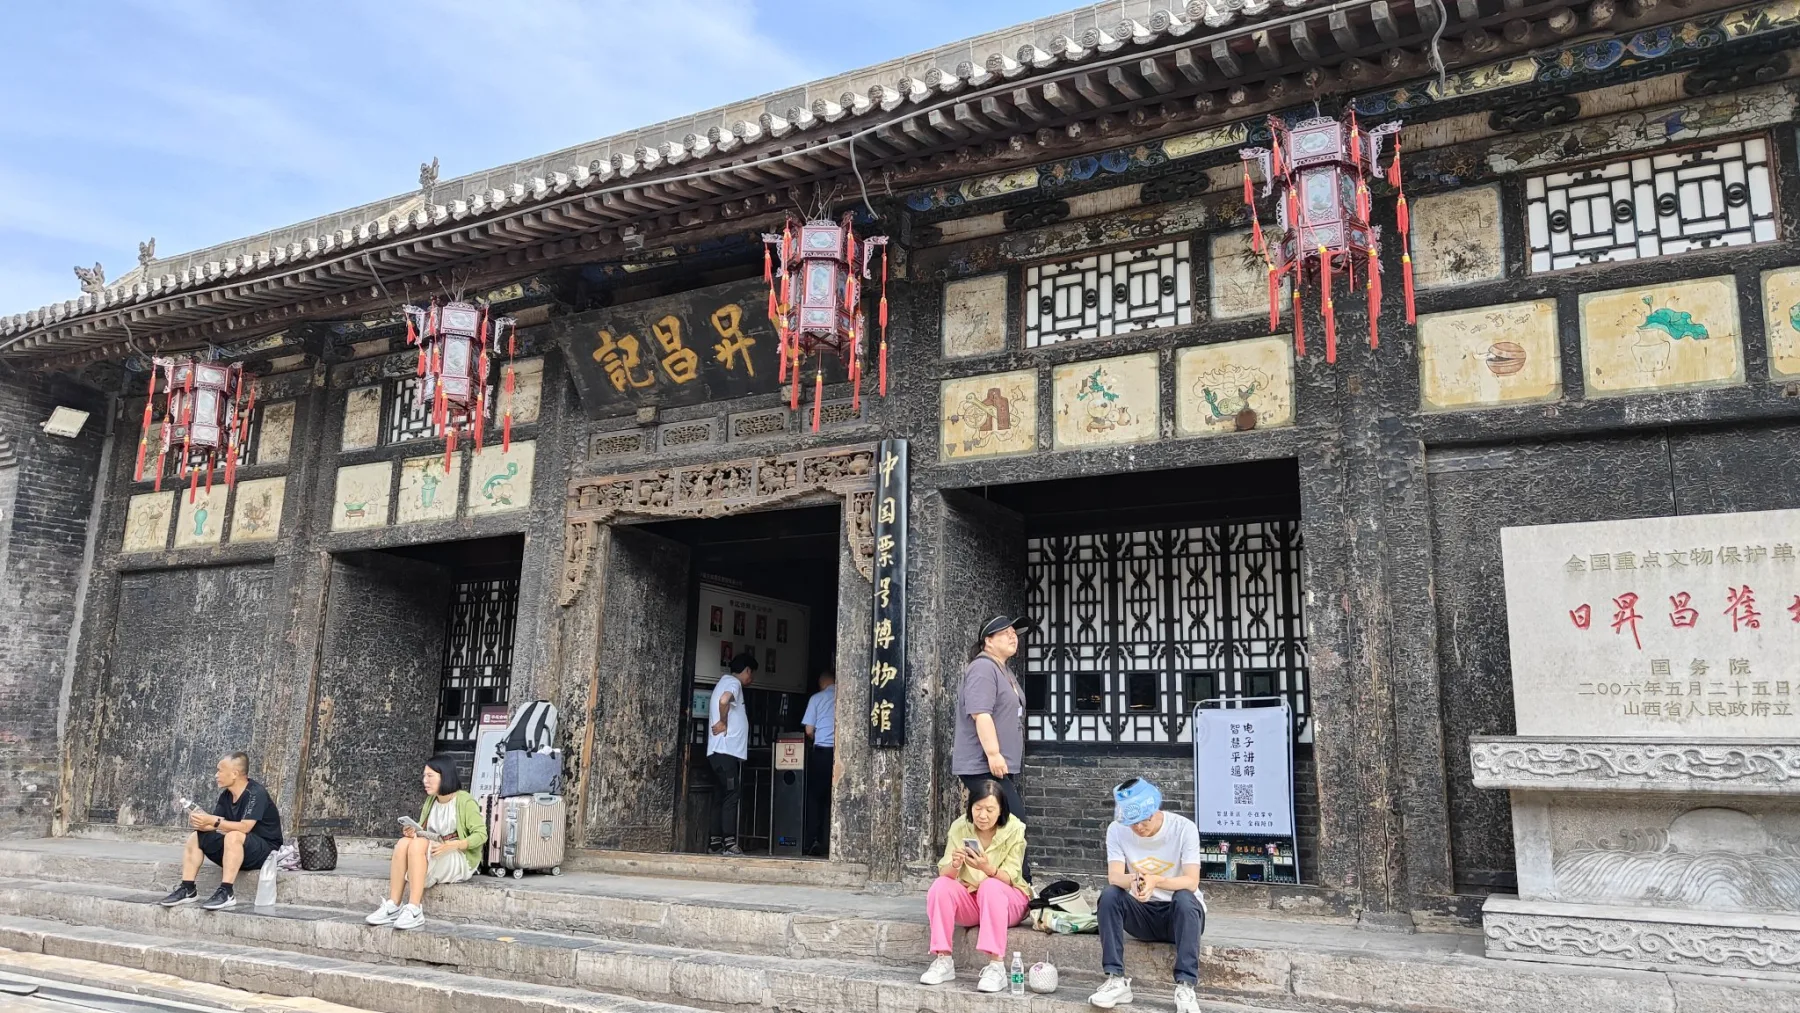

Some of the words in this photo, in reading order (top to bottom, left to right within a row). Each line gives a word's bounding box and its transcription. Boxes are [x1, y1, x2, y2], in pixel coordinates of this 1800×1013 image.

[1564, 543, 1800, 573] 全国重点文物保护单
[870, 451, 899, 733] 中国票号博物馆
[1651, 657, 1752, 676] 国务院
[1623, 701, 1794, 718] 山西省人民政府立
[1243, 722, 1256, 778] 电子讲解
